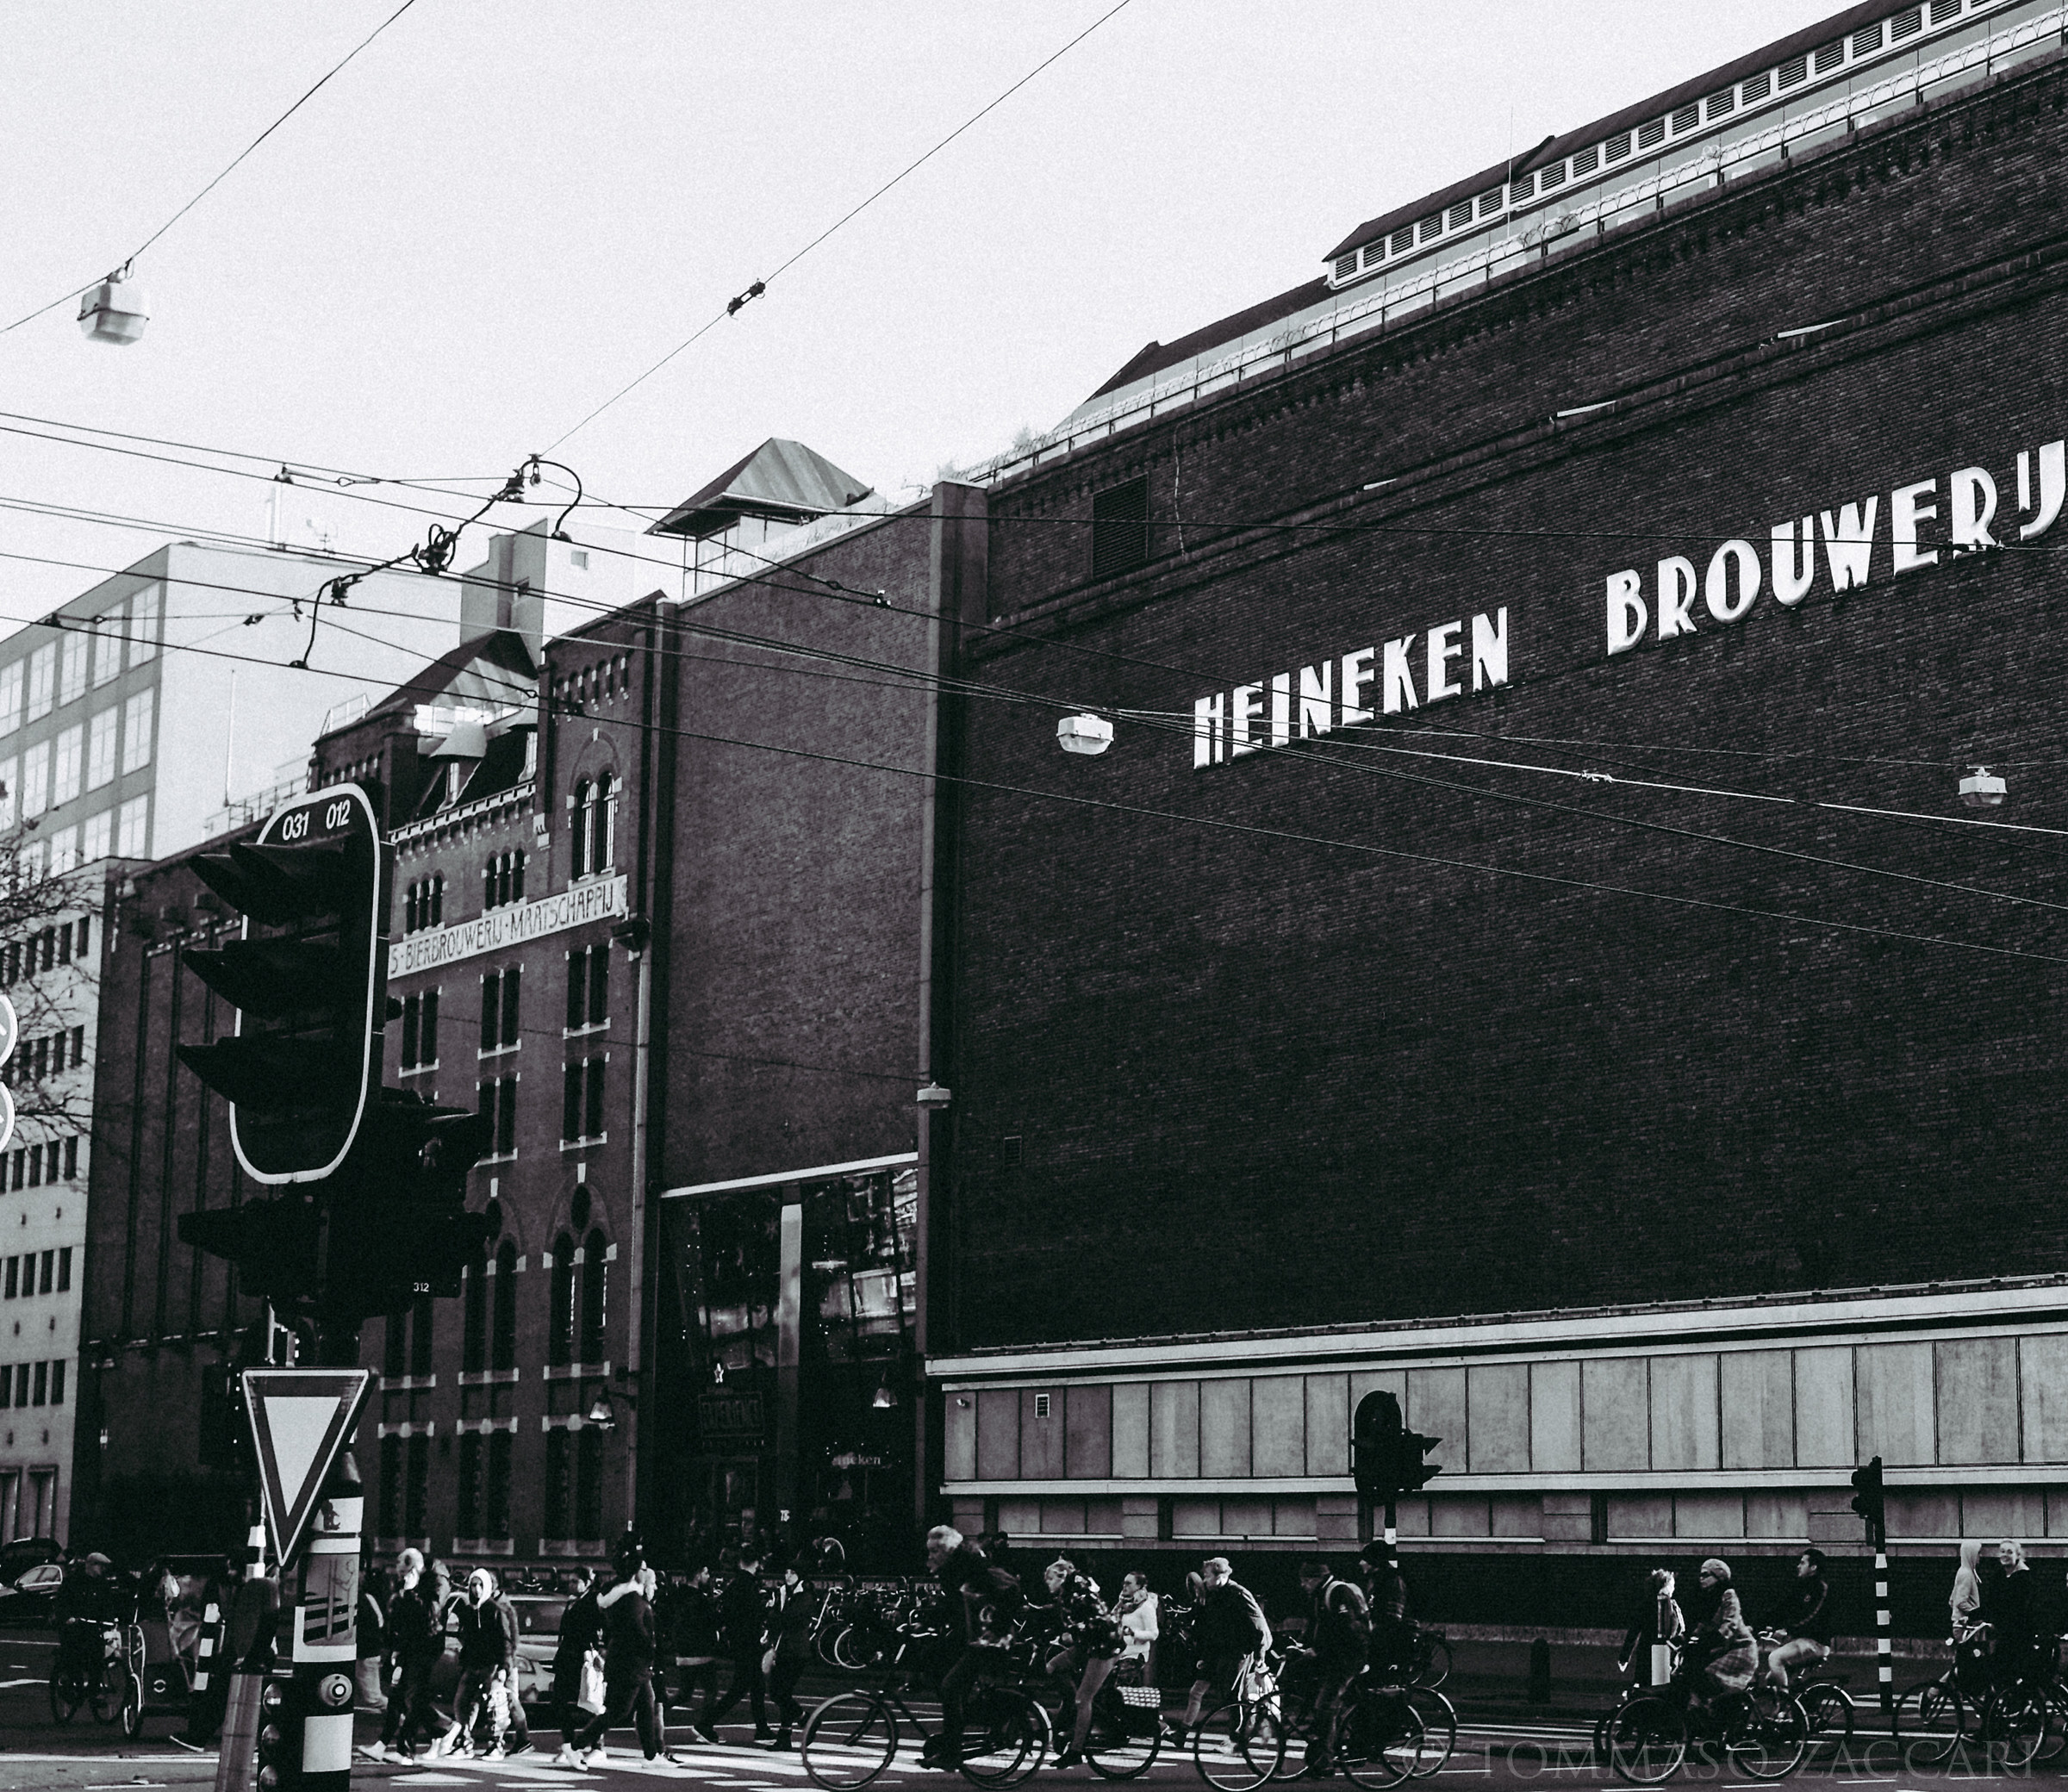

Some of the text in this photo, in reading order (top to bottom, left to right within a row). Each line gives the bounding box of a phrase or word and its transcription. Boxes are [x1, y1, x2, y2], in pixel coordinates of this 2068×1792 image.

[1193, 439, 2066, 769] HEINEKEN BROUWERIJ
[283, 800, 351, 841] 031 012
[414, 1282, 430, 1292] 312
